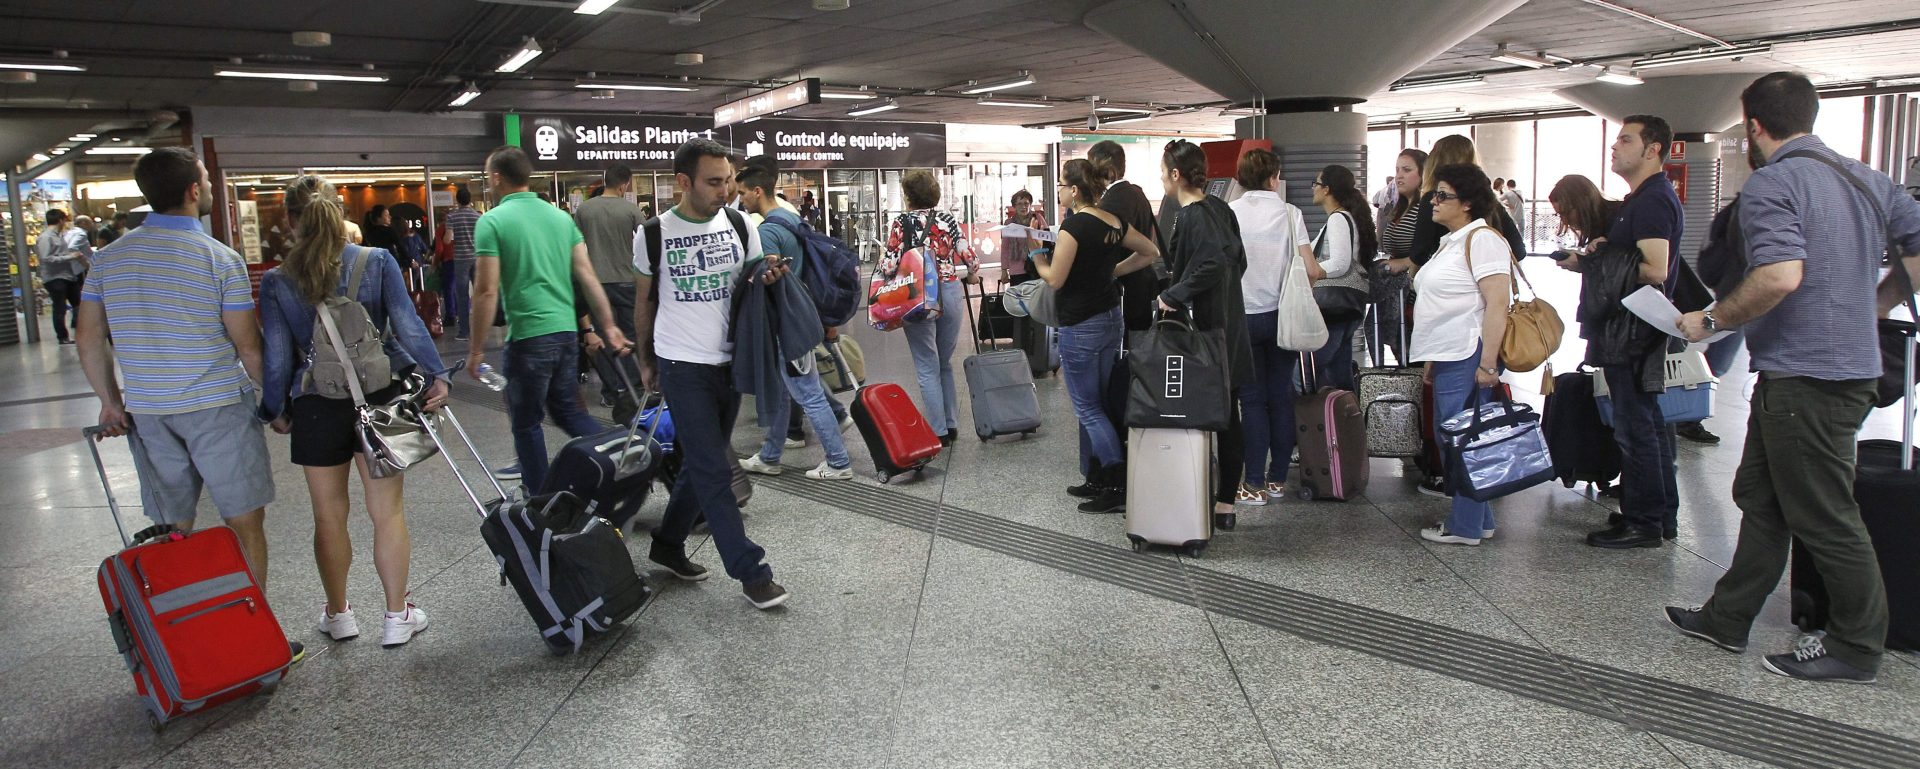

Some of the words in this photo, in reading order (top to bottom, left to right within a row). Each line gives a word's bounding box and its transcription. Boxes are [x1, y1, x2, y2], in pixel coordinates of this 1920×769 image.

[575, 125, 640, 144] Salidas
[645, 126, 699, 144] Planta
[704, 128, 713, 141] 1
[775, 131, 825, 148] Control
[829, 131, 846, 148] de
[849, 131, 910, 151] equipajes
[576, 150, 638, 160] DEPARTURES
[639, 150, 668, 160] FLOOR
[670, 150, 675, 160] 1
[776, 152, 811, 161] LUGGAGE
[813, 152, 845, 161] CONTROL
[664, 229, 734, 250] PROPERTY
[667, 249, 688, 265] OF
[668, 264, 696, 277] MID
[671, 271, 732, 292] WEST
[673, 287, 730, 302] LEAGUE
